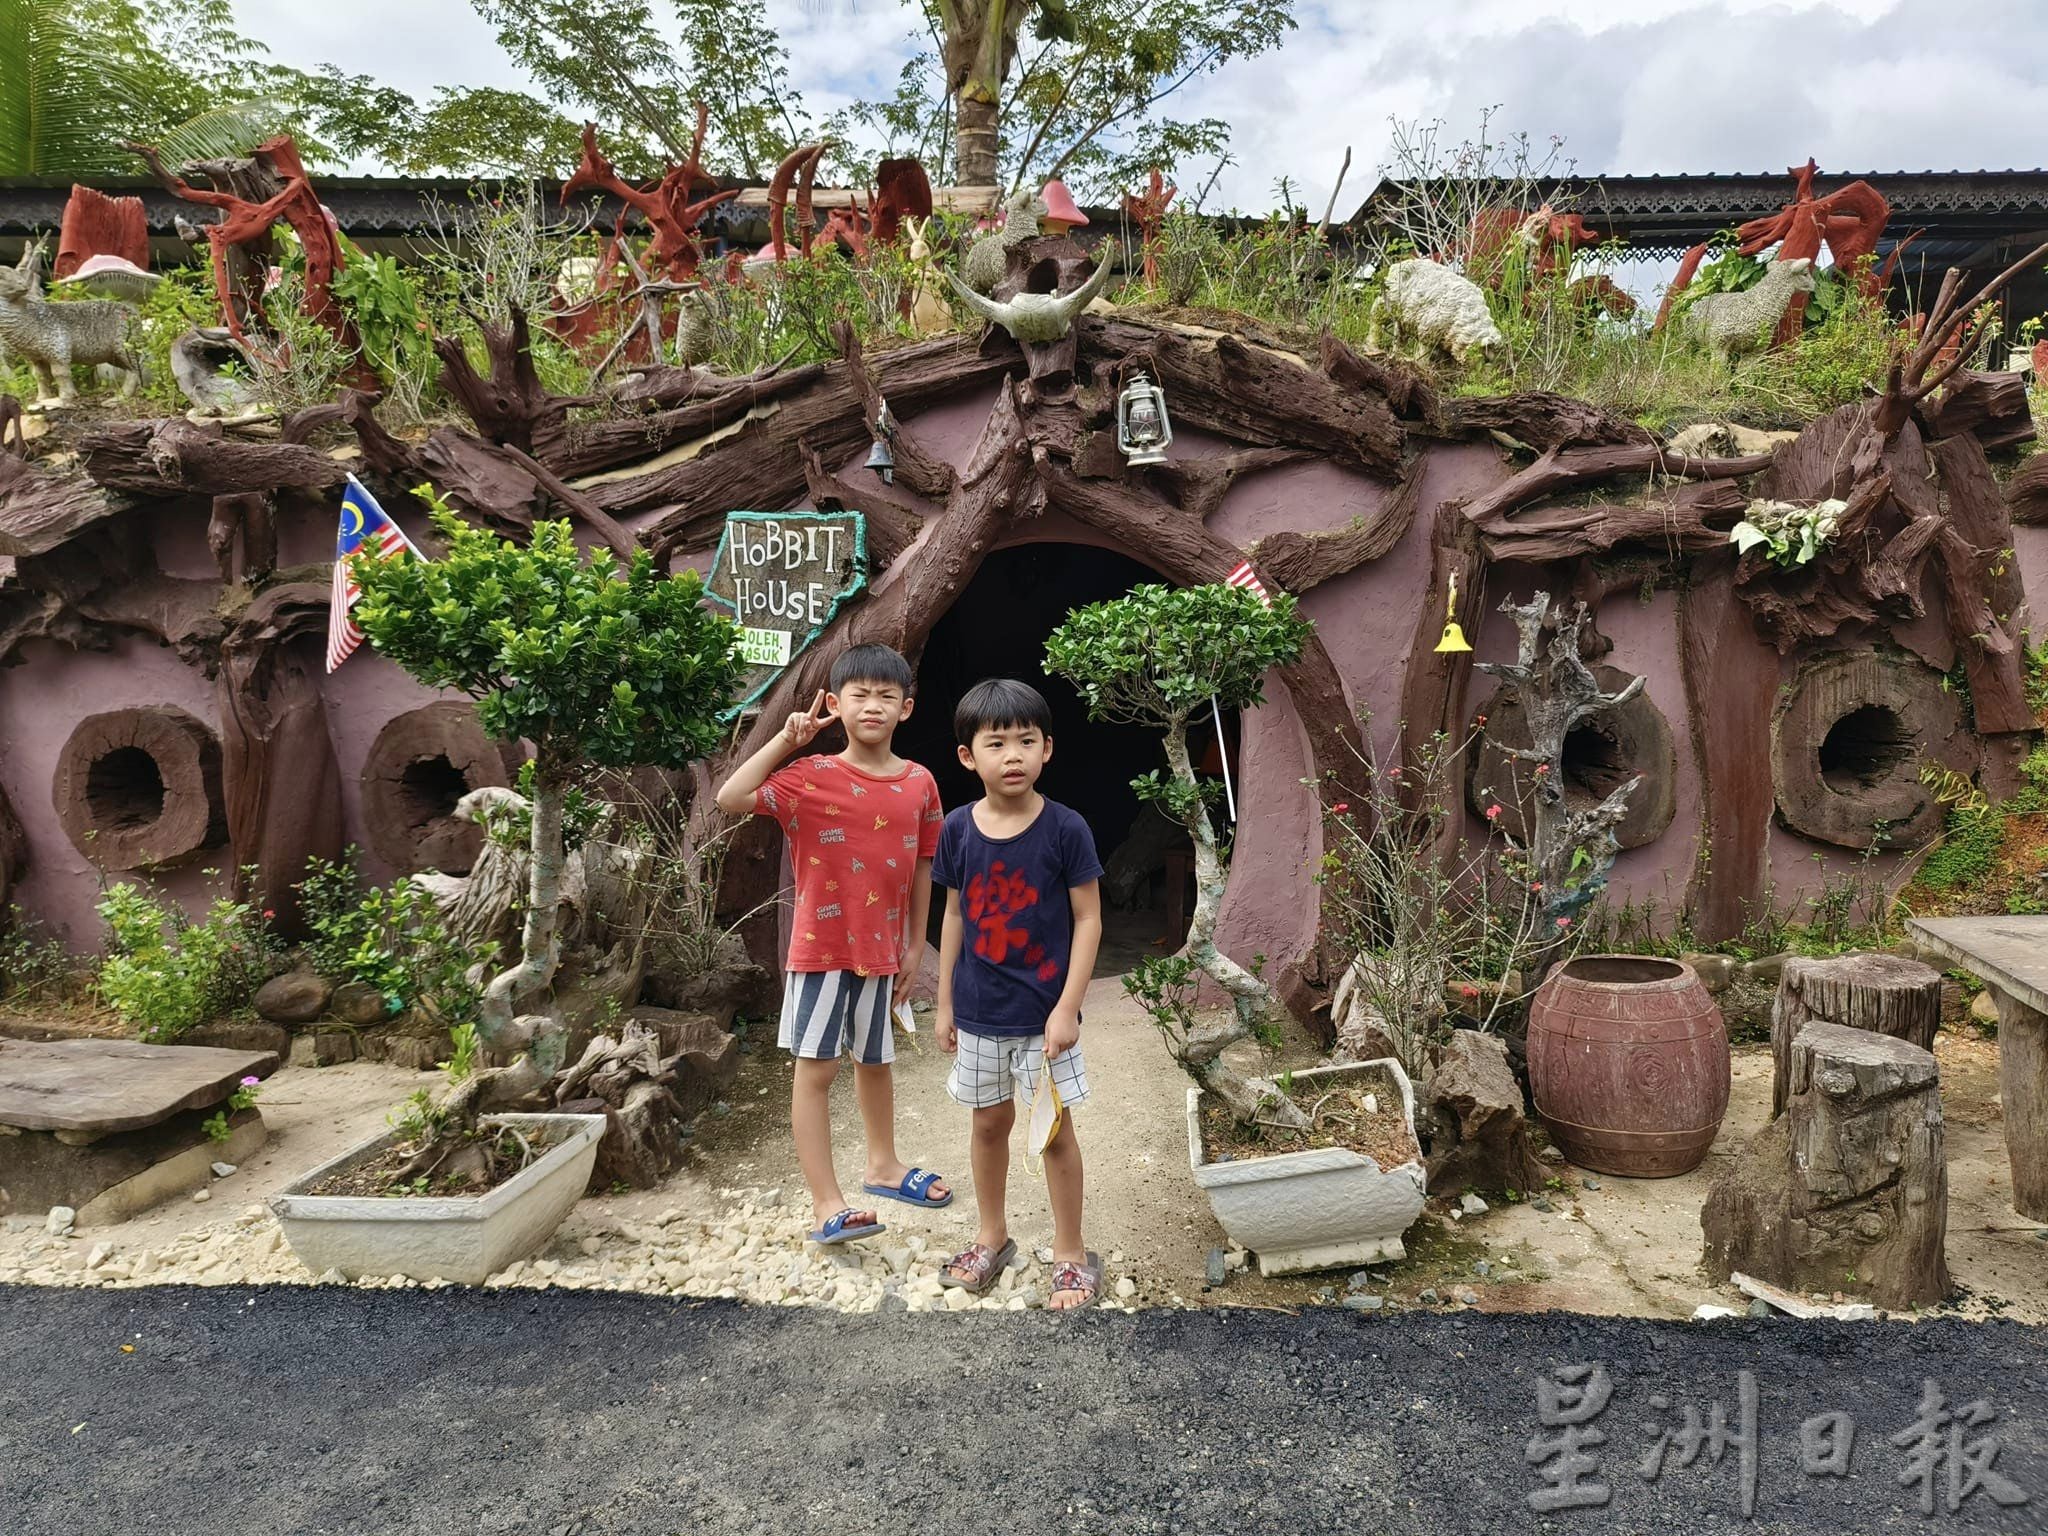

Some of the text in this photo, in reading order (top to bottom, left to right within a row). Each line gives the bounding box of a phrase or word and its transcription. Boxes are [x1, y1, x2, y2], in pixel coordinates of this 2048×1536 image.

[740, 646, 780, 664] ASUK
[819, 828, 844, 837] GAME
[820, 835, 845, 844] OVER
[817, 903, 841, 913] GAME
[818, 910, 841, 920] OVER
